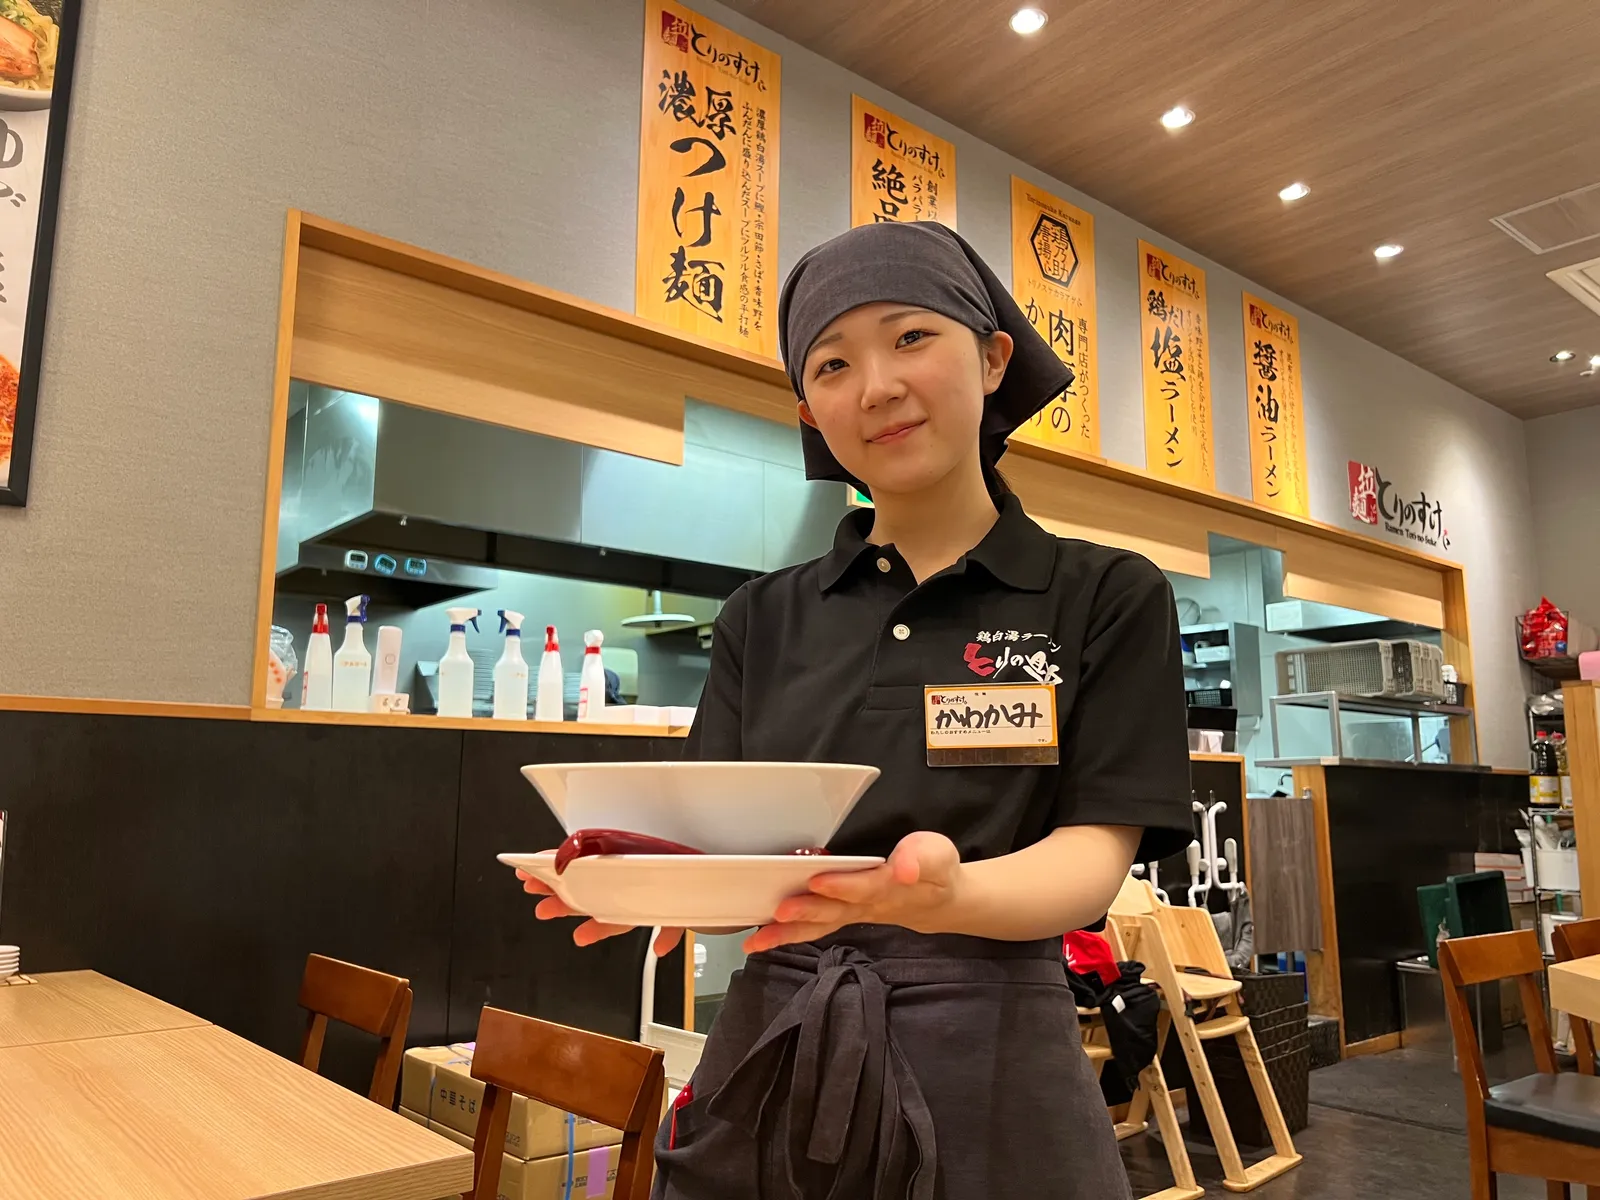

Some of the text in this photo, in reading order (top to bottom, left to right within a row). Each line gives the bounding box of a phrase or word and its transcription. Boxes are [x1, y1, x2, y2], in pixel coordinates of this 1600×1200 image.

[1077, 316, 1091, 440] 専門店がつくった
[1253, 339, 1281, 498] 醤油ラーメン
[1375, 465, 1443, 539] とりのすけ
[935, 702, 1044, 730] かわかみ
